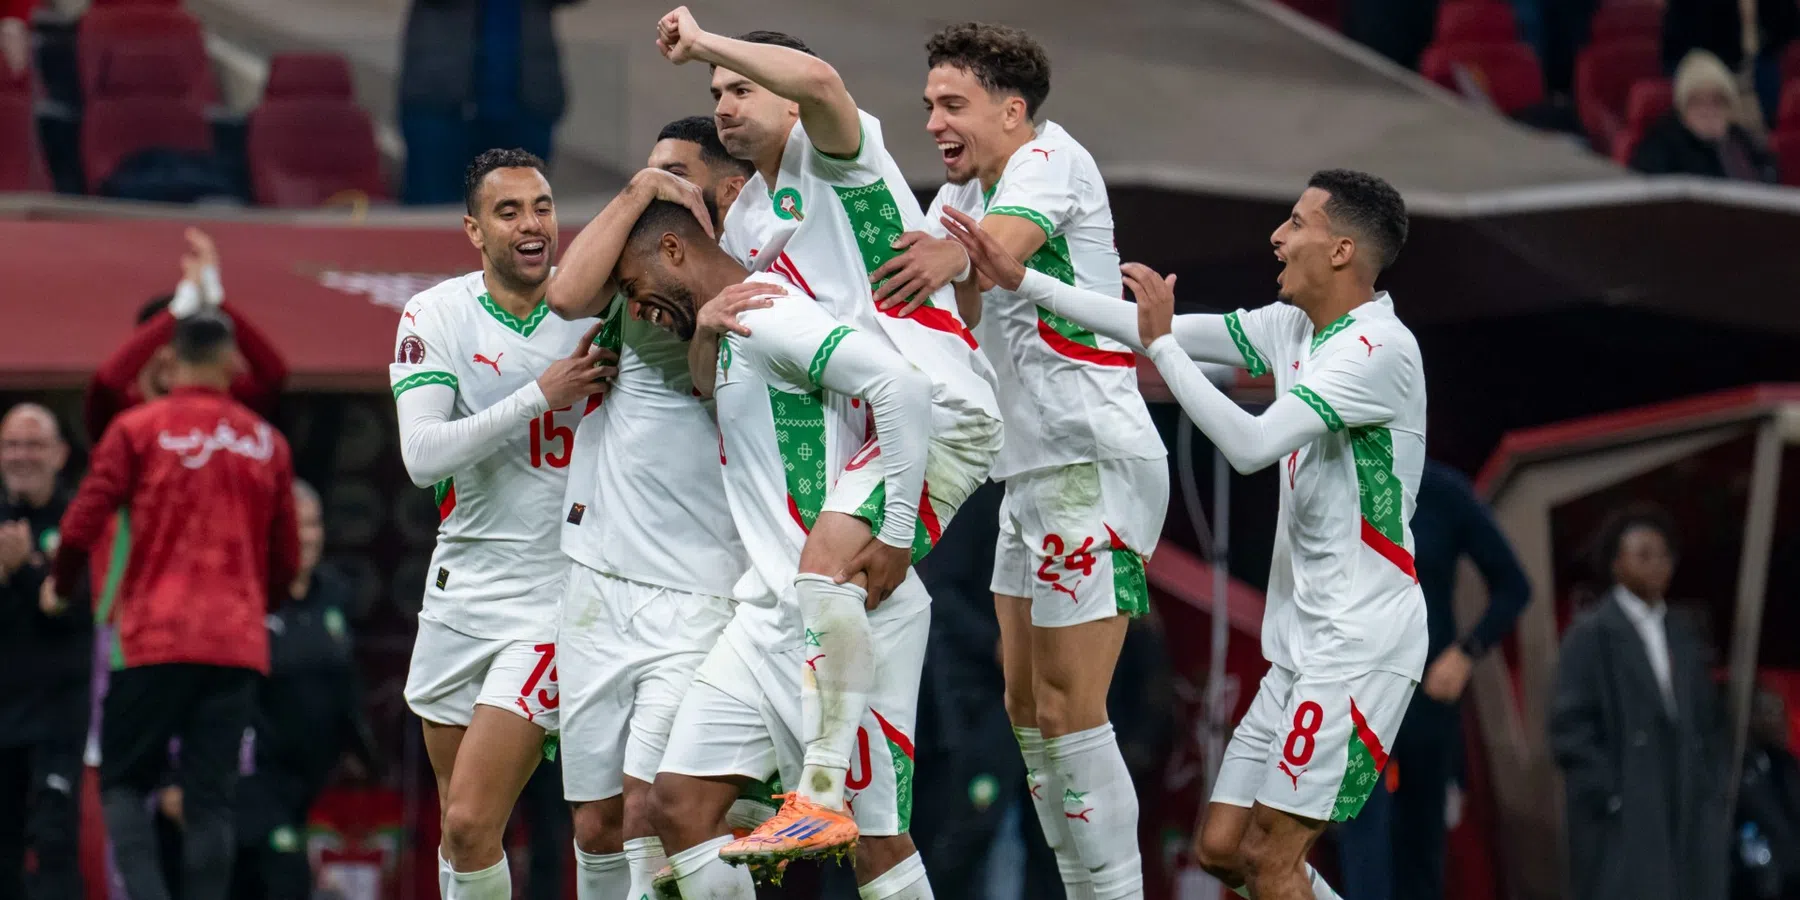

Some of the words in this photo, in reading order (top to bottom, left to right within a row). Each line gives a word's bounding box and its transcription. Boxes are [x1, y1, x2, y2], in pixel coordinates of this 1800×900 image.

[530, 405, 574, 468] 15
[1037, 533, 1096, 582] 24
[1283, 700, 1323, 766] 8
